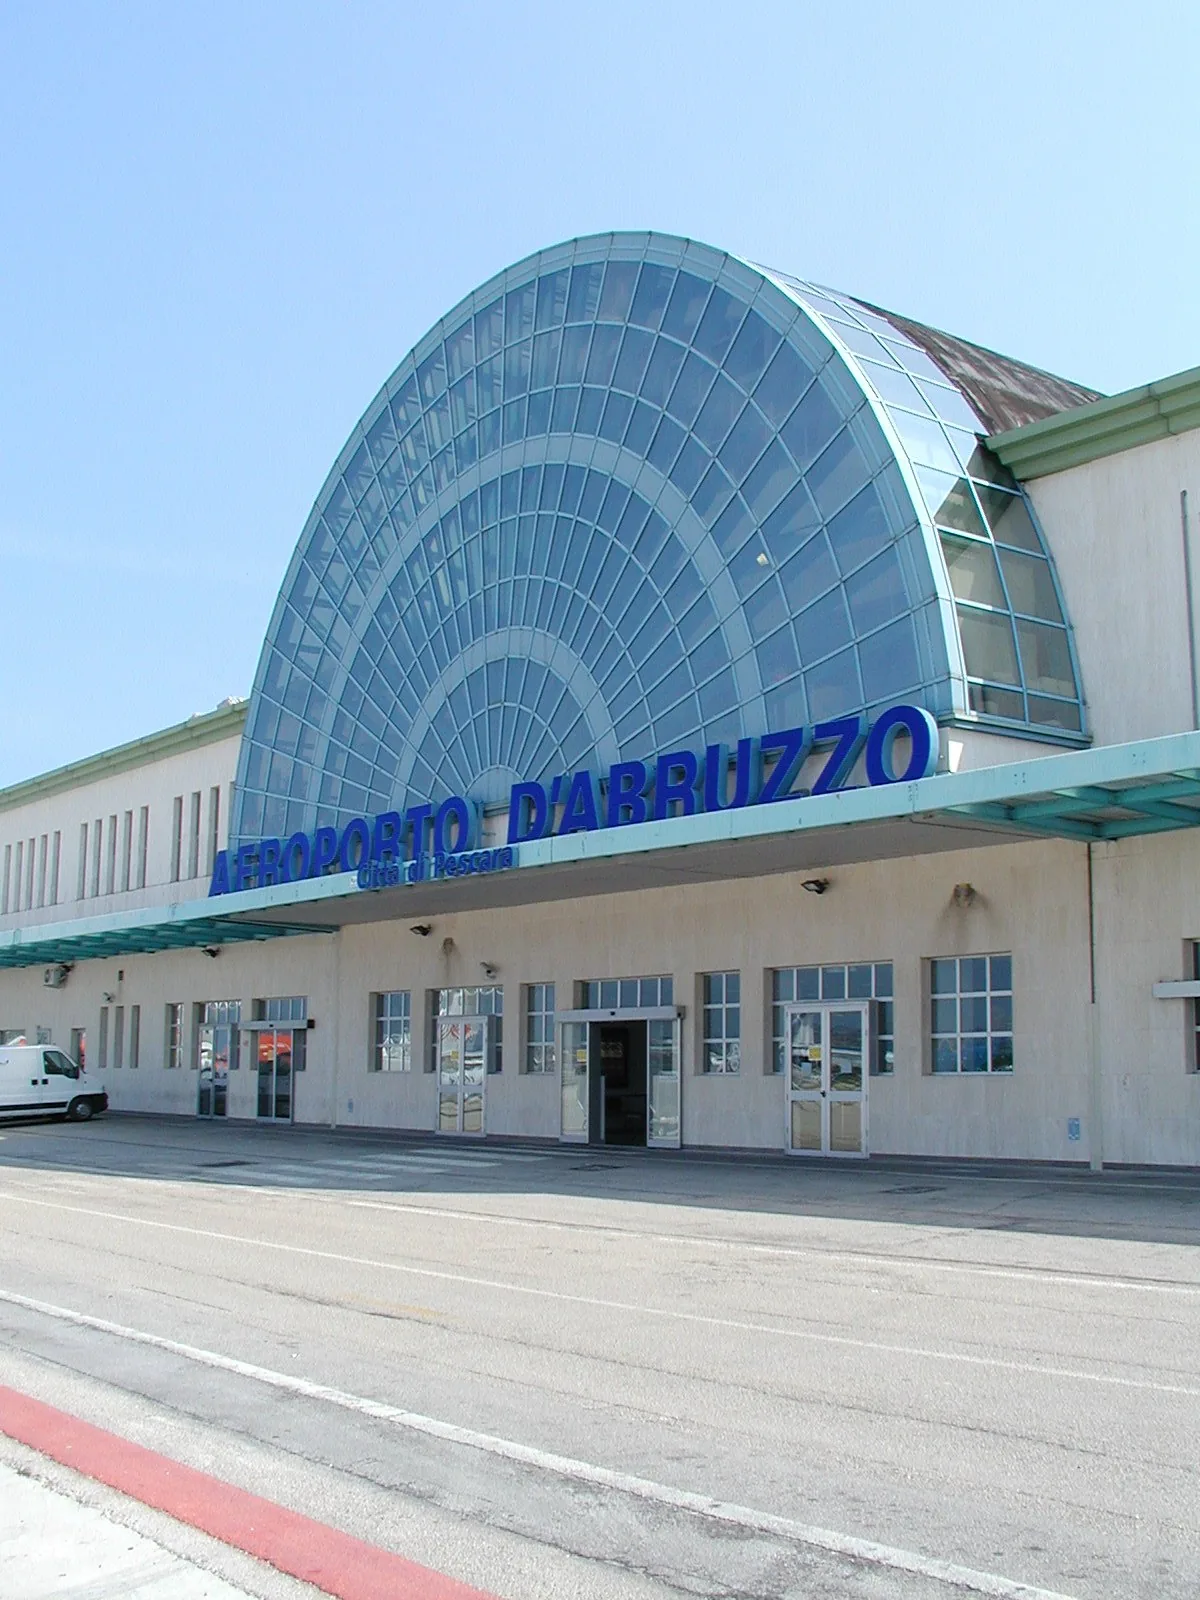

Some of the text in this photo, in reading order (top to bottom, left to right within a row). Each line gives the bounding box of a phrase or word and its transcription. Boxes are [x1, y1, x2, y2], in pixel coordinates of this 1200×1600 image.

[208, 704, 934, 897] AEROPORTO D'ABRUZZO
[408, 850, 430, 883] di
[434, 847, 514, 879] Pescara
